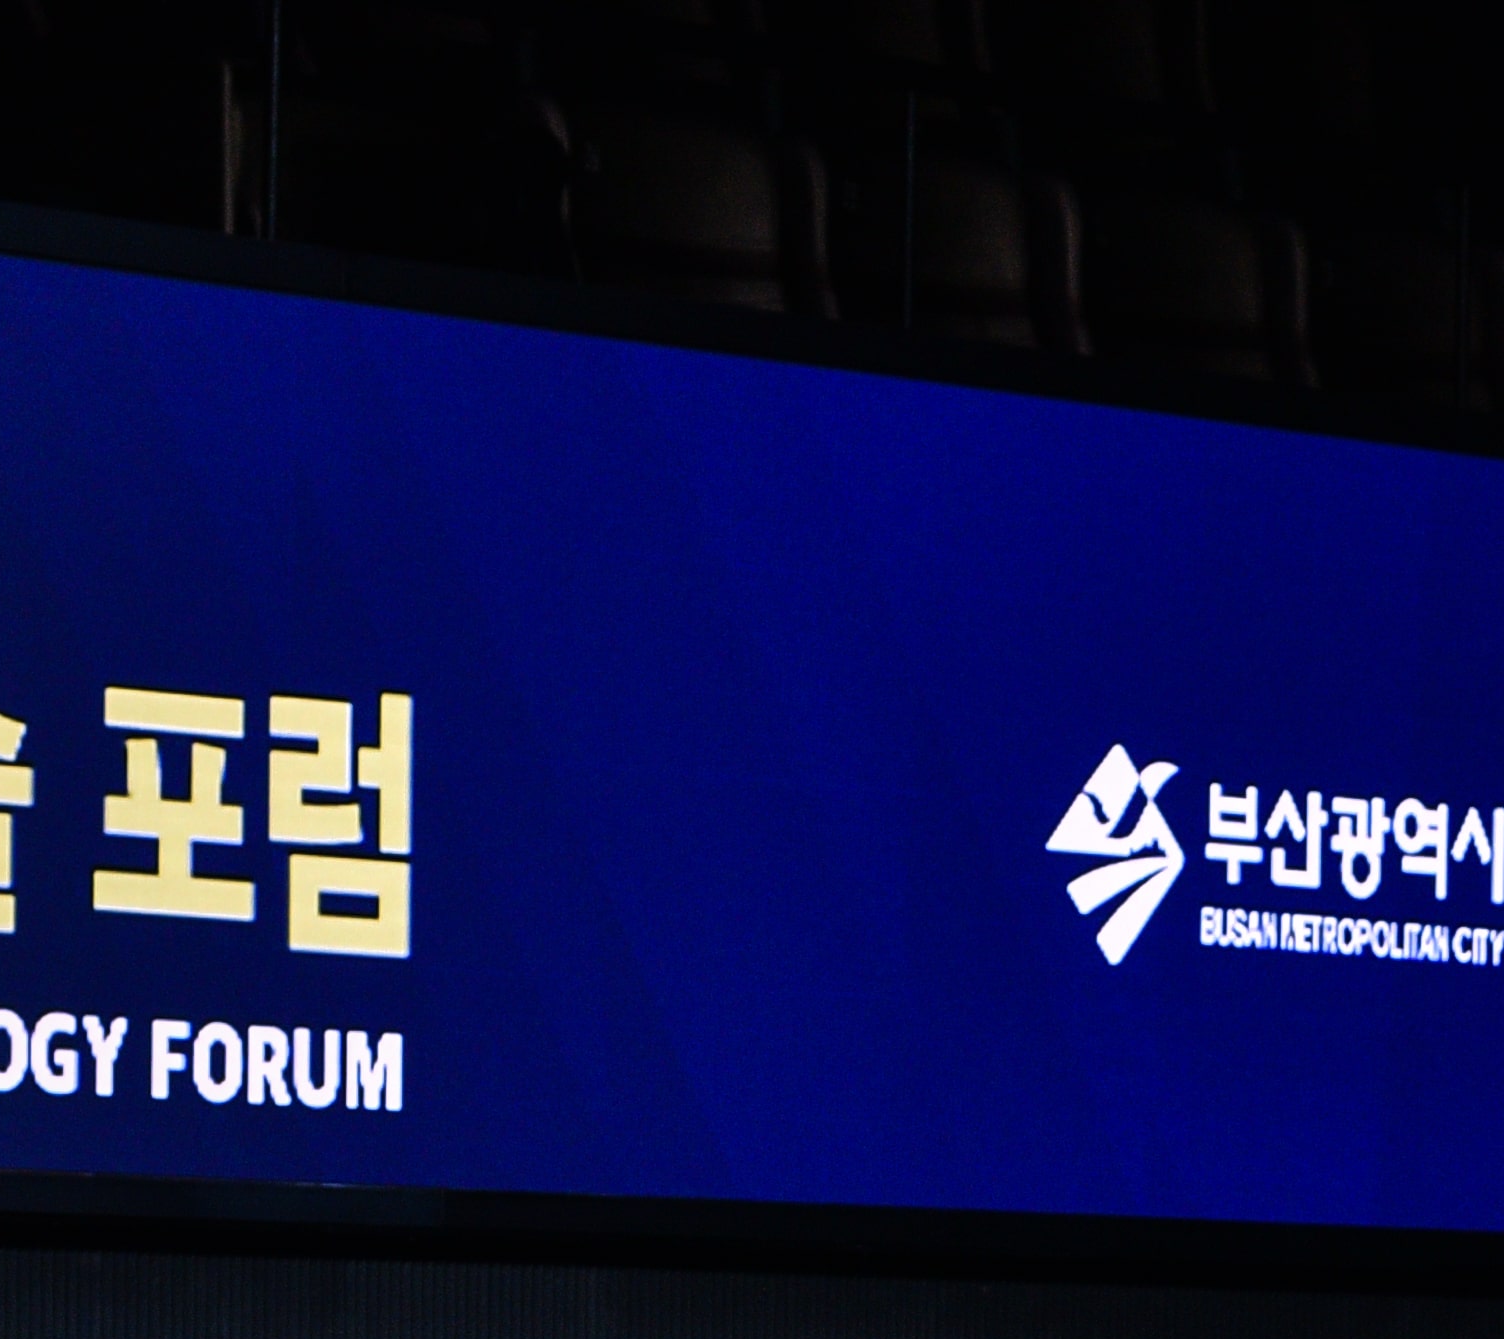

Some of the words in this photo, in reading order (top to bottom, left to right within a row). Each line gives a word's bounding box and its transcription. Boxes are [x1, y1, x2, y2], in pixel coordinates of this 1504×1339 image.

[93, 687, 412, 958] 포럼
[1200, 906, 1277, 949] BUSAN
[1280, 912, 1449, 962] METROPOLITAN
[151, 1018, 404, 1112] FORUM
